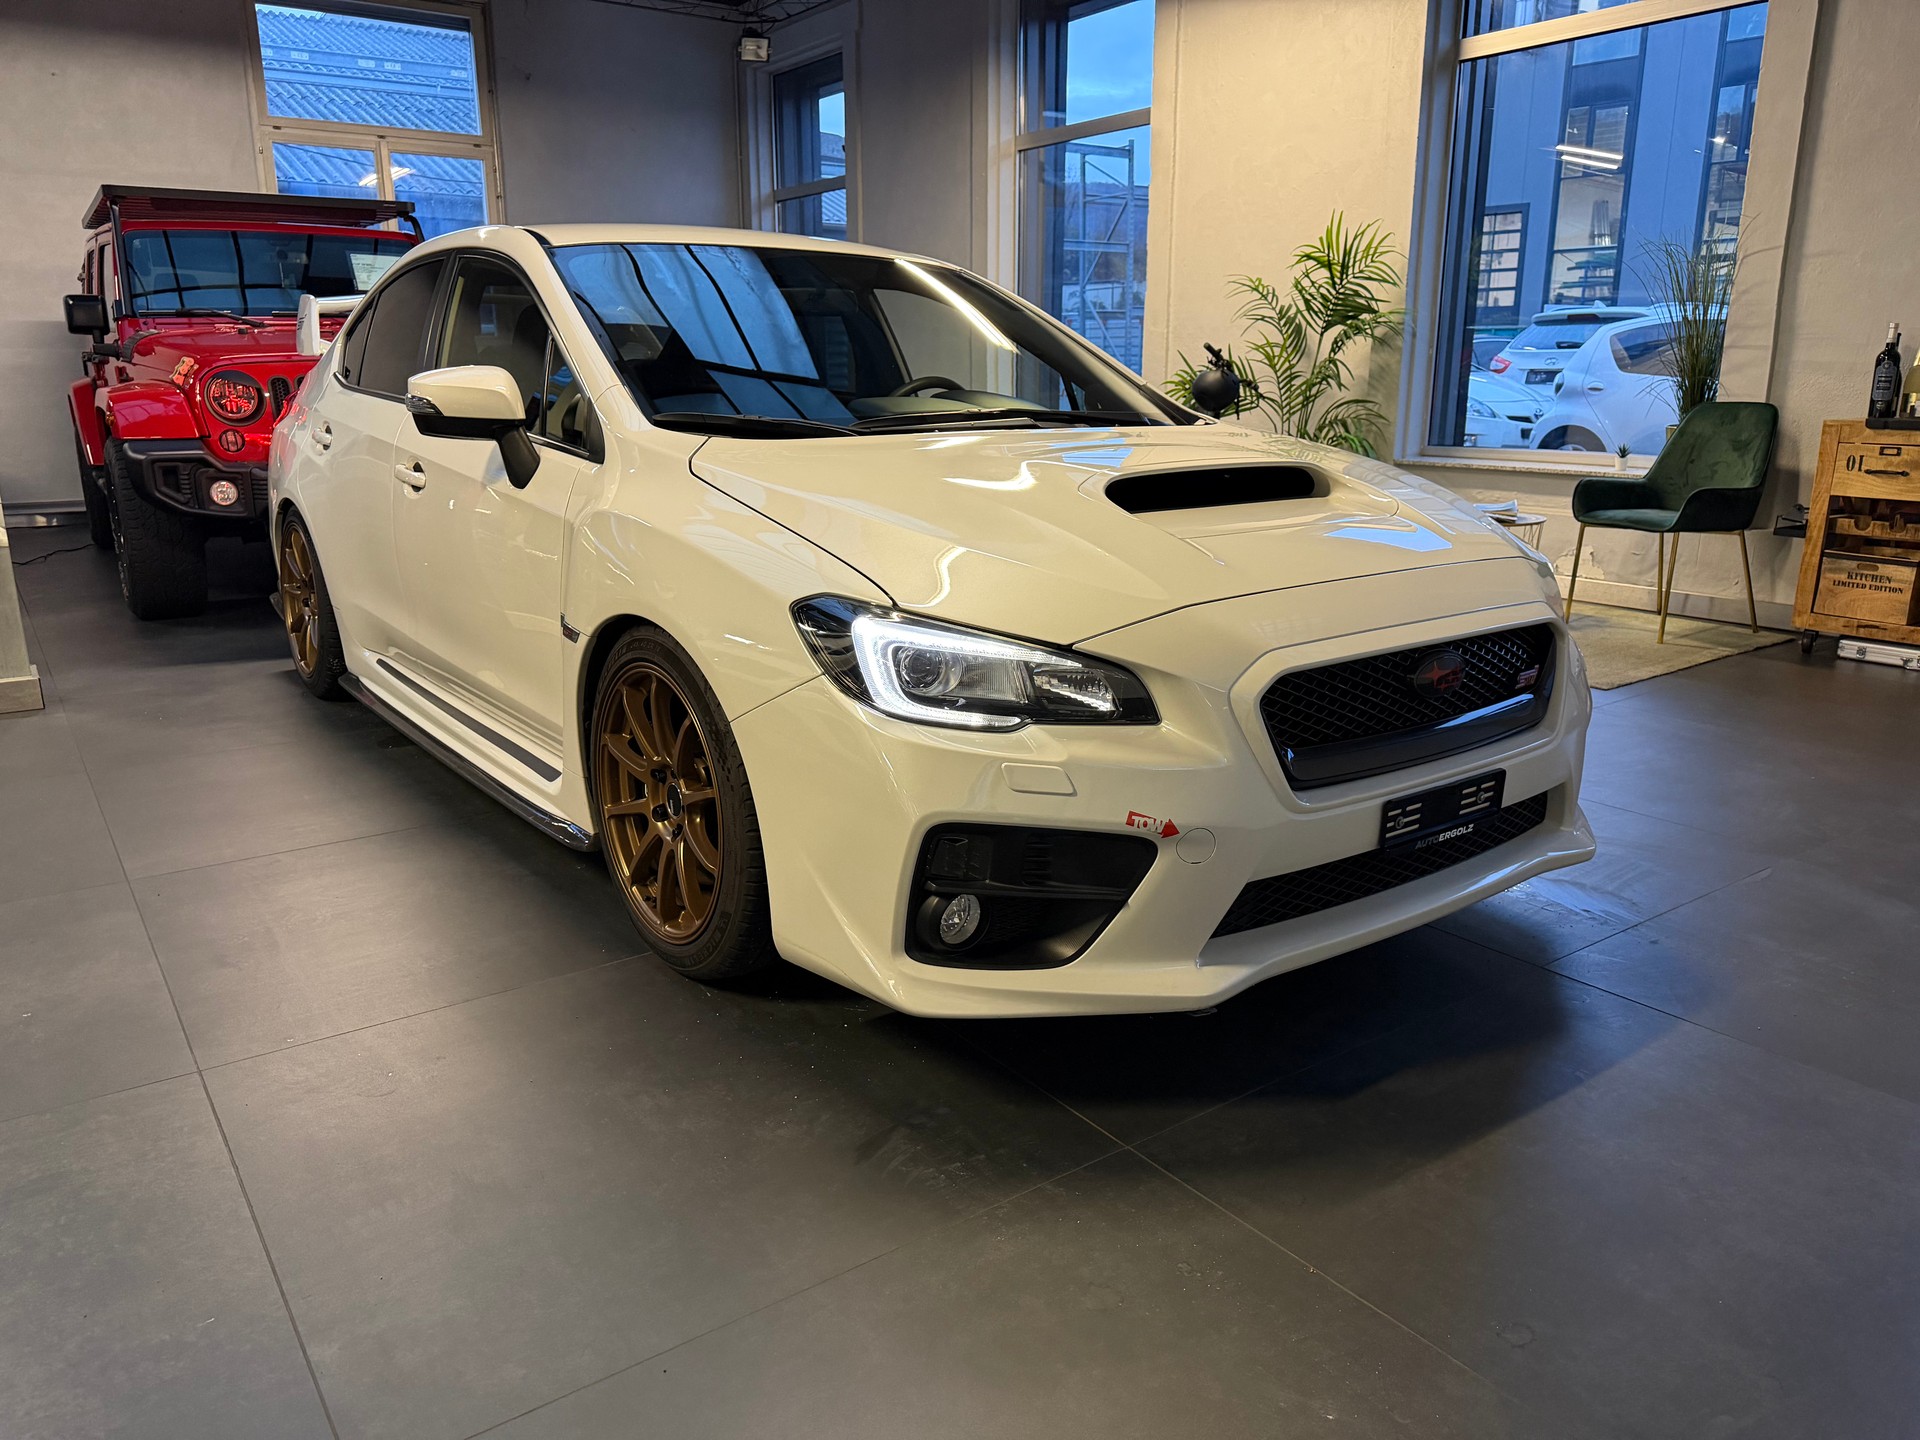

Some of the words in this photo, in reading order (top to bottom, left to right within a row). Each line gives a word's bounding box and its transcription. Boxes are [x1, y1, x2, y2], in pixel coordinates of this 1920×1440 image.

[1847, 571, 1892, 584] KITCHEN
[1833, 580, 1866, 589] LIMITED
[1869, 584, 1904, 594] EDITION
[1131, 815, 1165, 832] TOW
